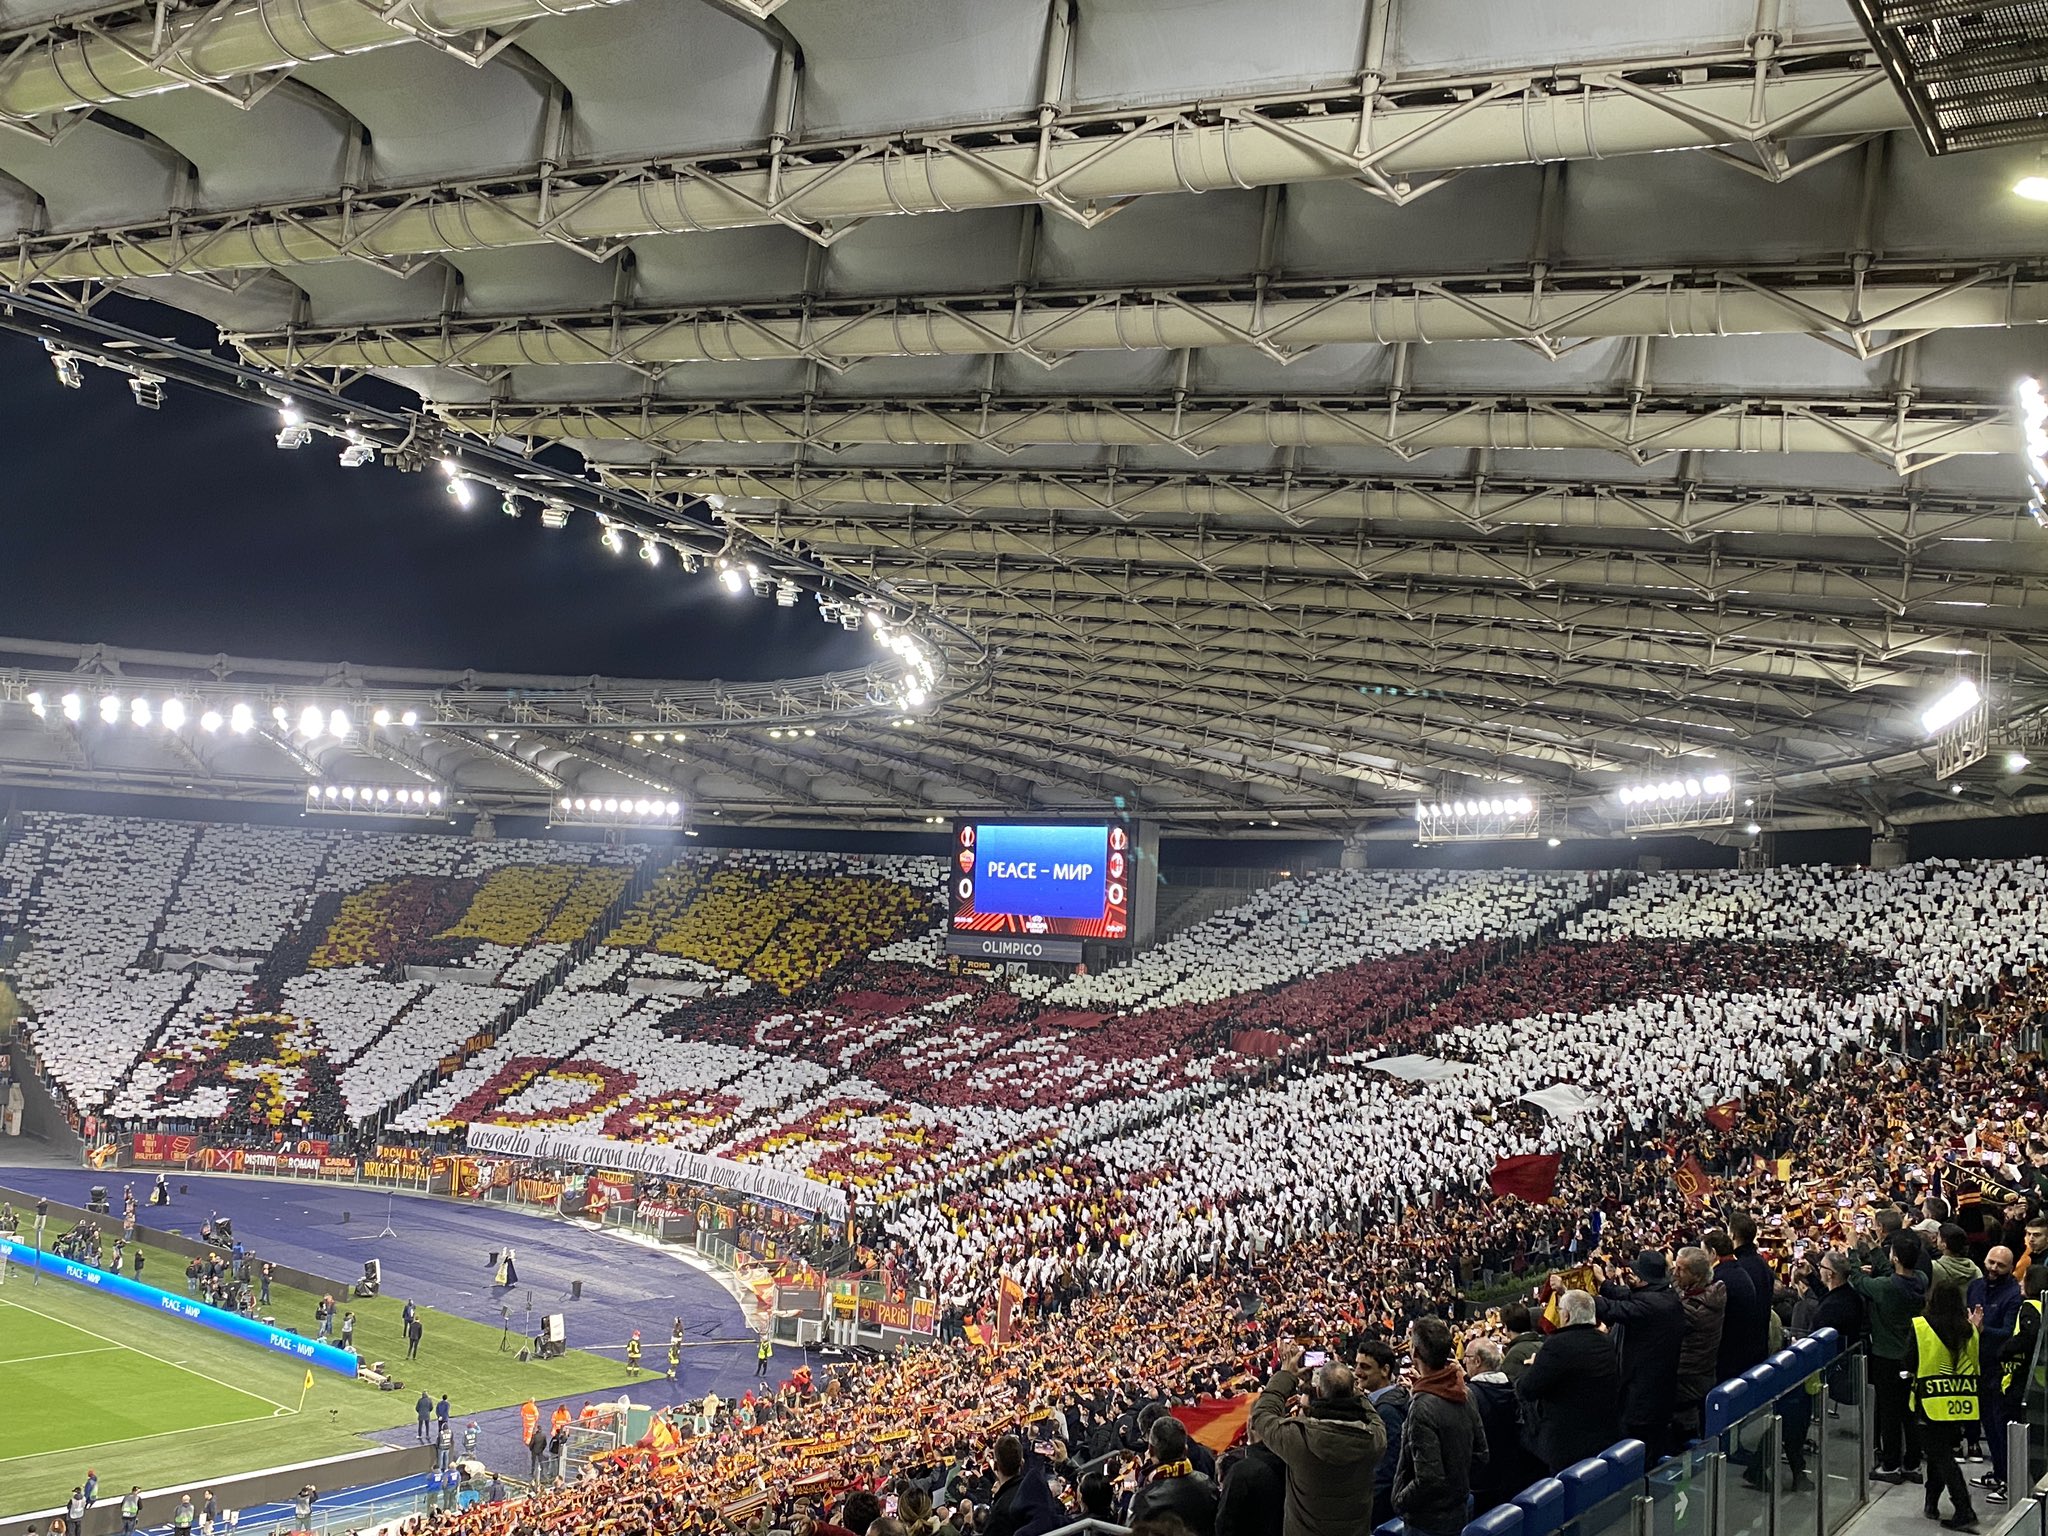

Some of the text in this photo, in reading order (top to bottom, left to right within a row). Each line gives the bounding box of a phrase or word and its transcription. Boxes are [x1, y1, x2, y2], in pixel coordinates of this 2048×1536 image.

[988, 862, 1037, 879] PEACE
[958, 878, 973, 899] 0
[1108, 883, 1124, 905] 0
[982, 940, 1043, 956] OLIMPICO
[967, 961, 990, 969] ROMA
[244, 1153, 320, 1170] DISTINTI ROMANI
[324, 1157, 351, 1167] CASAL
[364, 1161, 400, 1178] BRIGATA
[471, 1130, 530, 1154] orgoglio
[535, 1134, 550, 1156] di
[552, 1142, 581, 1160] una
[583, 1145, 622, 1166] curva
[627, 1144, 669, 1173] intera,
[675, 1152, 687, 1176] il
[688, 1157, 708, 1181] tuo
[710, 1166, 741, 1188] nome
[754, 1168, 765, 1192] la
[766, 1175, 800, 1204] nostra
[802, 1182, 846, 1217] bandiera
[66, 1265, 83, 1279] PEACE
[162, 1297, 180, 1312] PEACE
[914, 1300, 934, 1317] AVE
[270, 1333, 291, 1350] PEACE
[1947, 1400, 1973, 1415] 209
